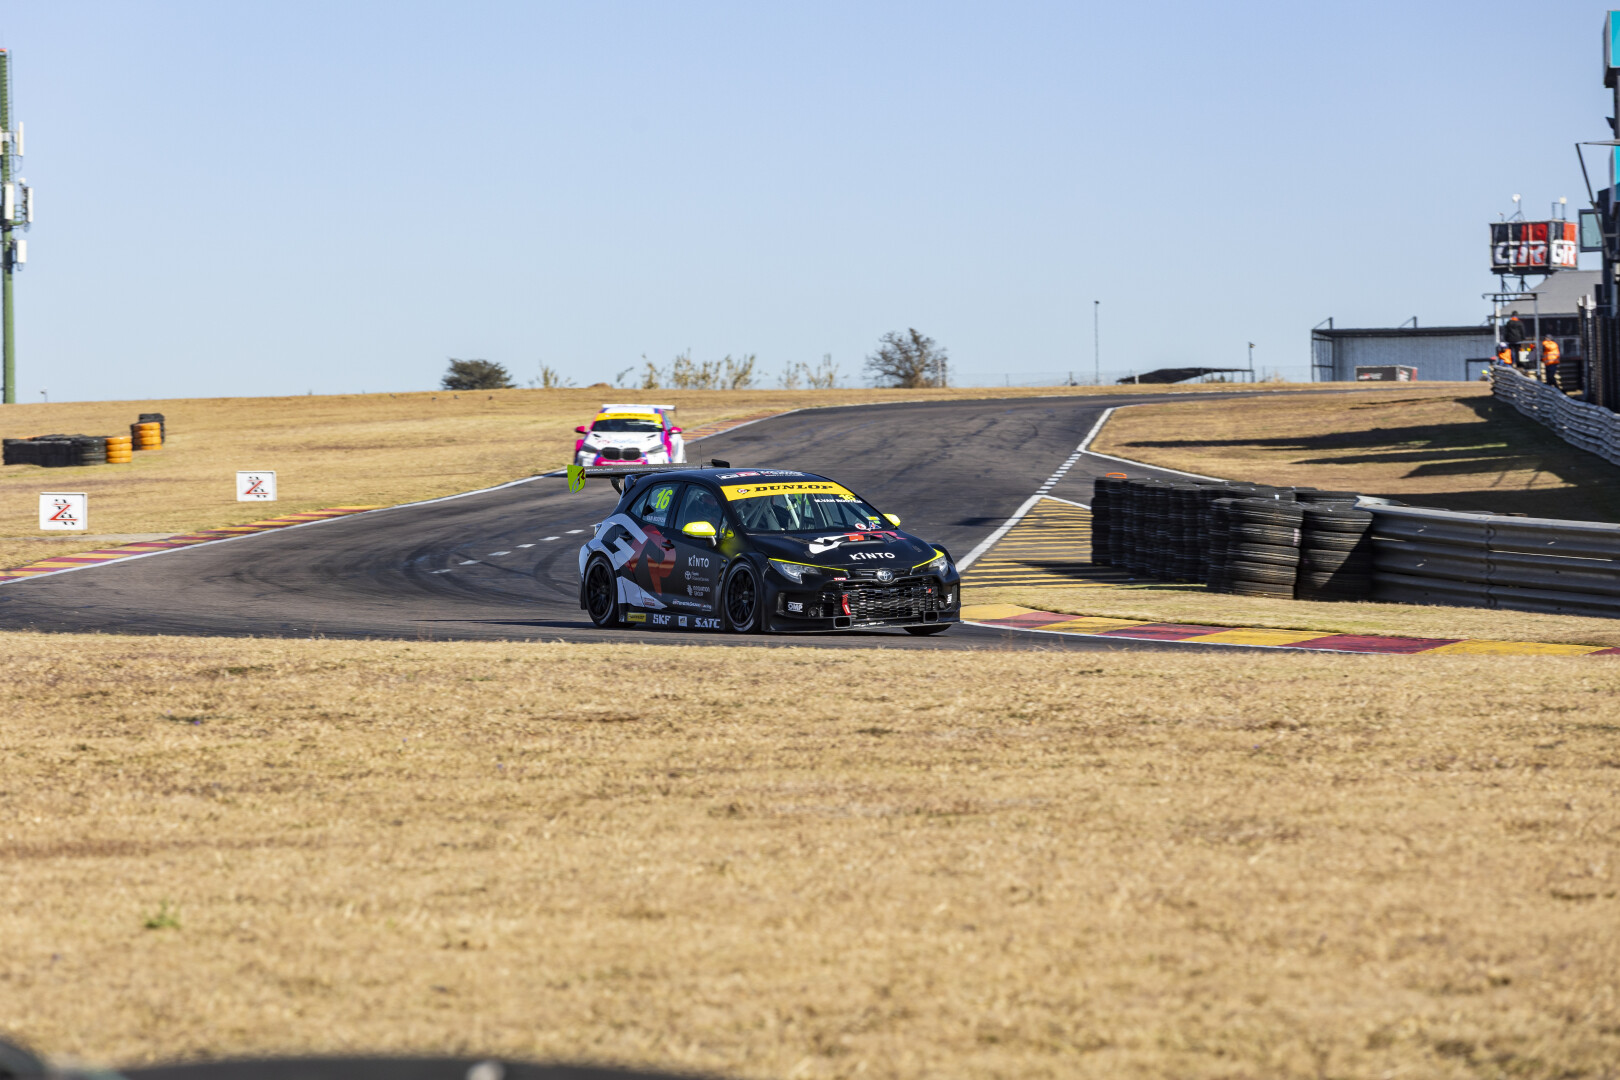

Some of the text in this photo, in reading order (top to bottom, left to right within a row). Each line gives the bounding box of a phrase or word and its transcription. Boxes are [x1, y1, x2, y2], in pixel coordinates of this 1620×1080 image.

[1551, 239, 1577, 267] GR
[754, 484, 834, 493] DUNLOP
[655, 488, 673, 510] 16
[688, 554, 710, 568] KINTO
[849, 552, 896, 561] KINTO
[787, 602, 803, 613] OMP
[652, 613, 671, 625] SKF
[694, 617, 721, 629] SATC
